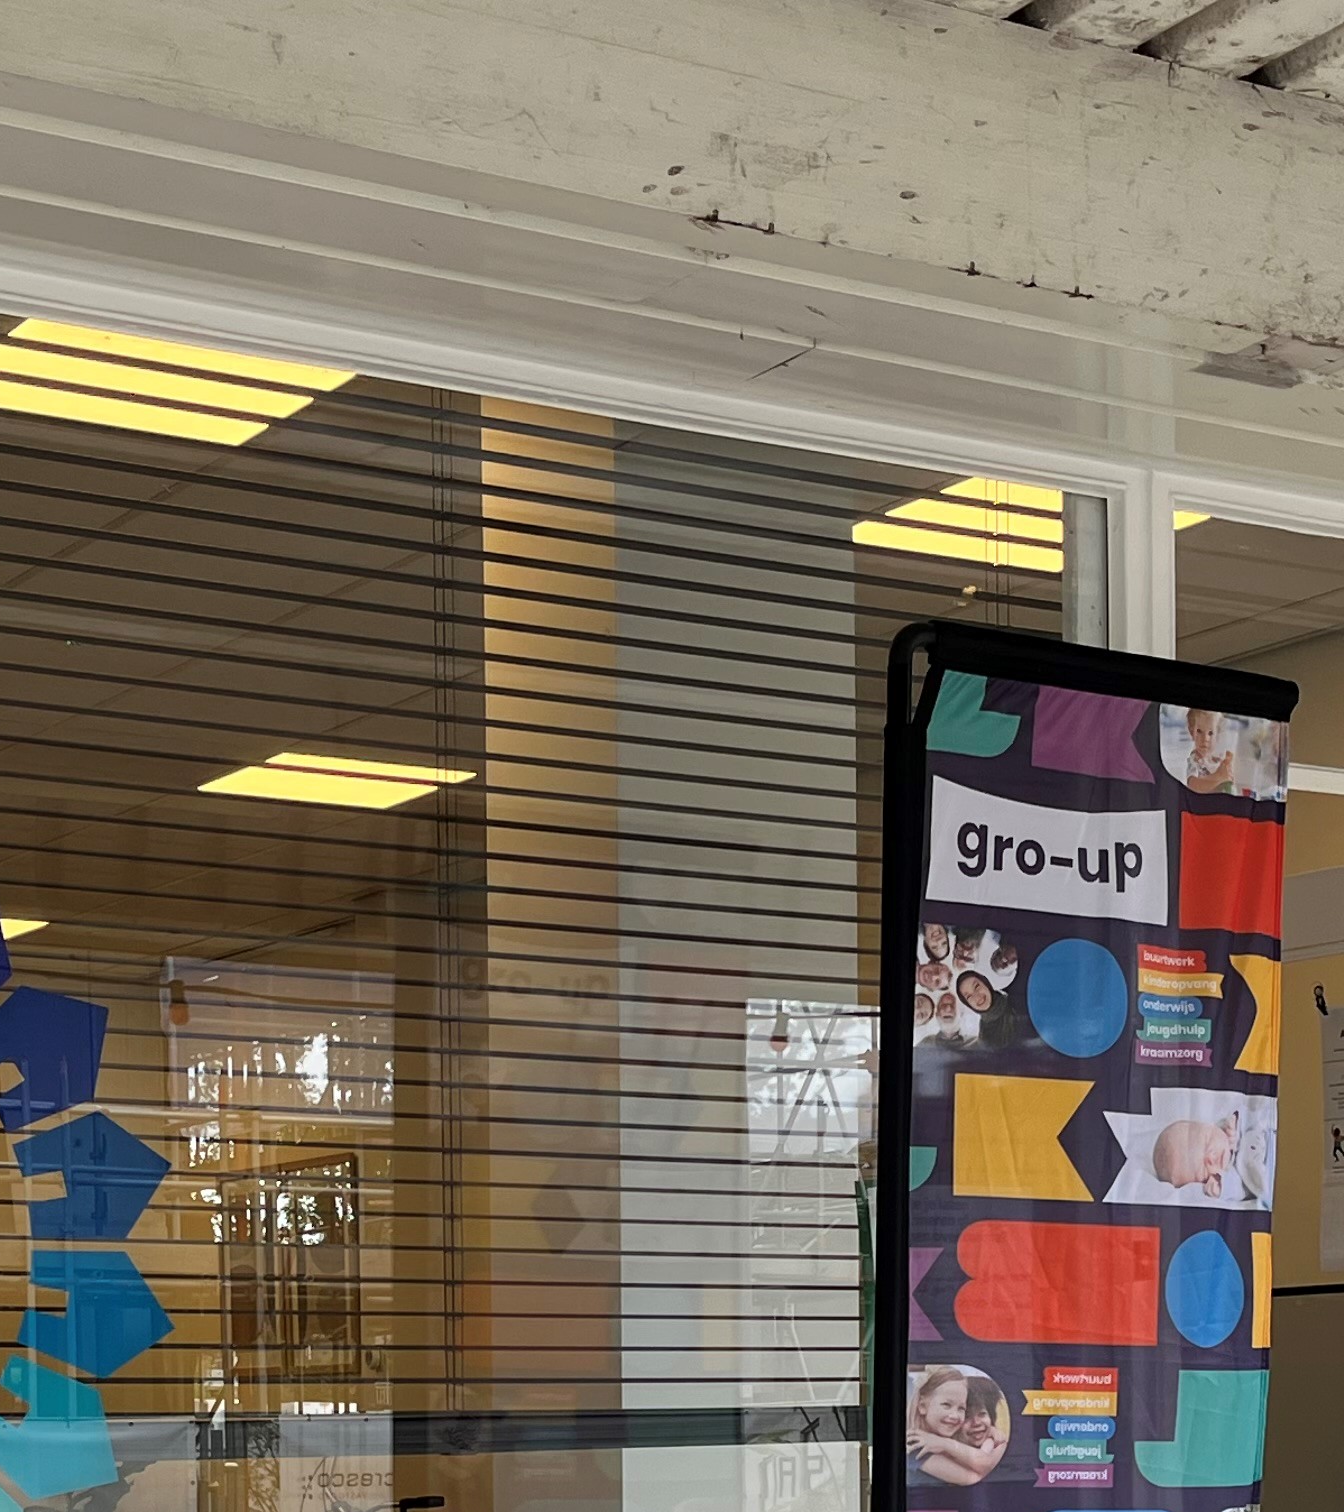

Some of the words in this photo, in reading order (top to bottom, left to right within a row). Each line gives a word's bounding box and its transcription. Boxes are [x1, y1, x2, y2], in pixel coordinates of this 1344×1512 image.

[957, 820, 1143, 893] gro-up
[1143, 950, 1195, 967] buurtwerk
[1143, 974, 1217, 993] kinderopvang
[1143, 999, 1195, 1015] onderwijs
[1146, 1023, 1206, 1039] jeugdhulp
[1140, 1045, 1204, 1062] kraamzorg
